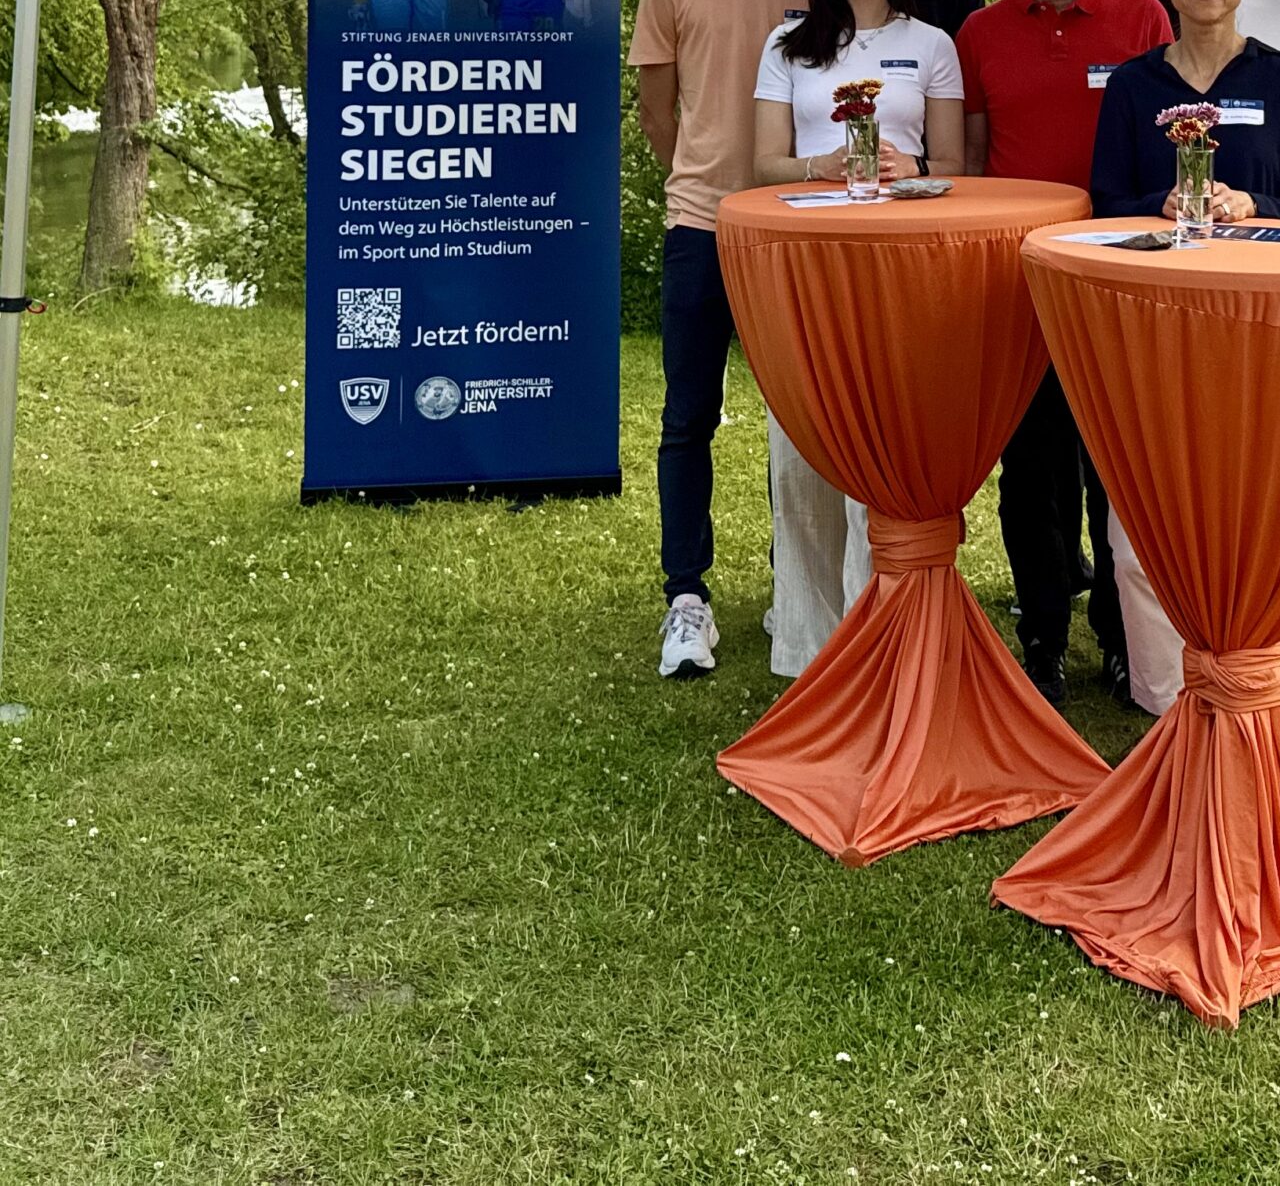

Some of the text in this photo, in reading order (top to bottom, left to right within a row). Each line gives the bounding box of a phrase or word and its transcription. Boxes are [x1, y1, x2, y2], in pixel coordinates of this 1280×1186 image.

[341, 31, 574, 43] STIFTUNG JENAER UNIVERSITÄTSSPORT
[342, 52, 542, 93] FÖRDERN
[341, 102, 577, 137] STUDIEREN
[340, 147, 492, 181] SIEGEN
[339, 191, 557, 212] Unterstützen Sie Talente auf
[338, 221, 375, 236] dem
[378, 220, 414, 239] Weg
[417, 223, 436, 235] zu
[440, 216, 573, 234] Höchstleistungen
[338, 240, 532, 263] im Sport und im Studium
[411, 319, 569, 347] Jetzt fördern!
[345, 384, 384, 401] USV
[460, 400, 497, 414] JENA
